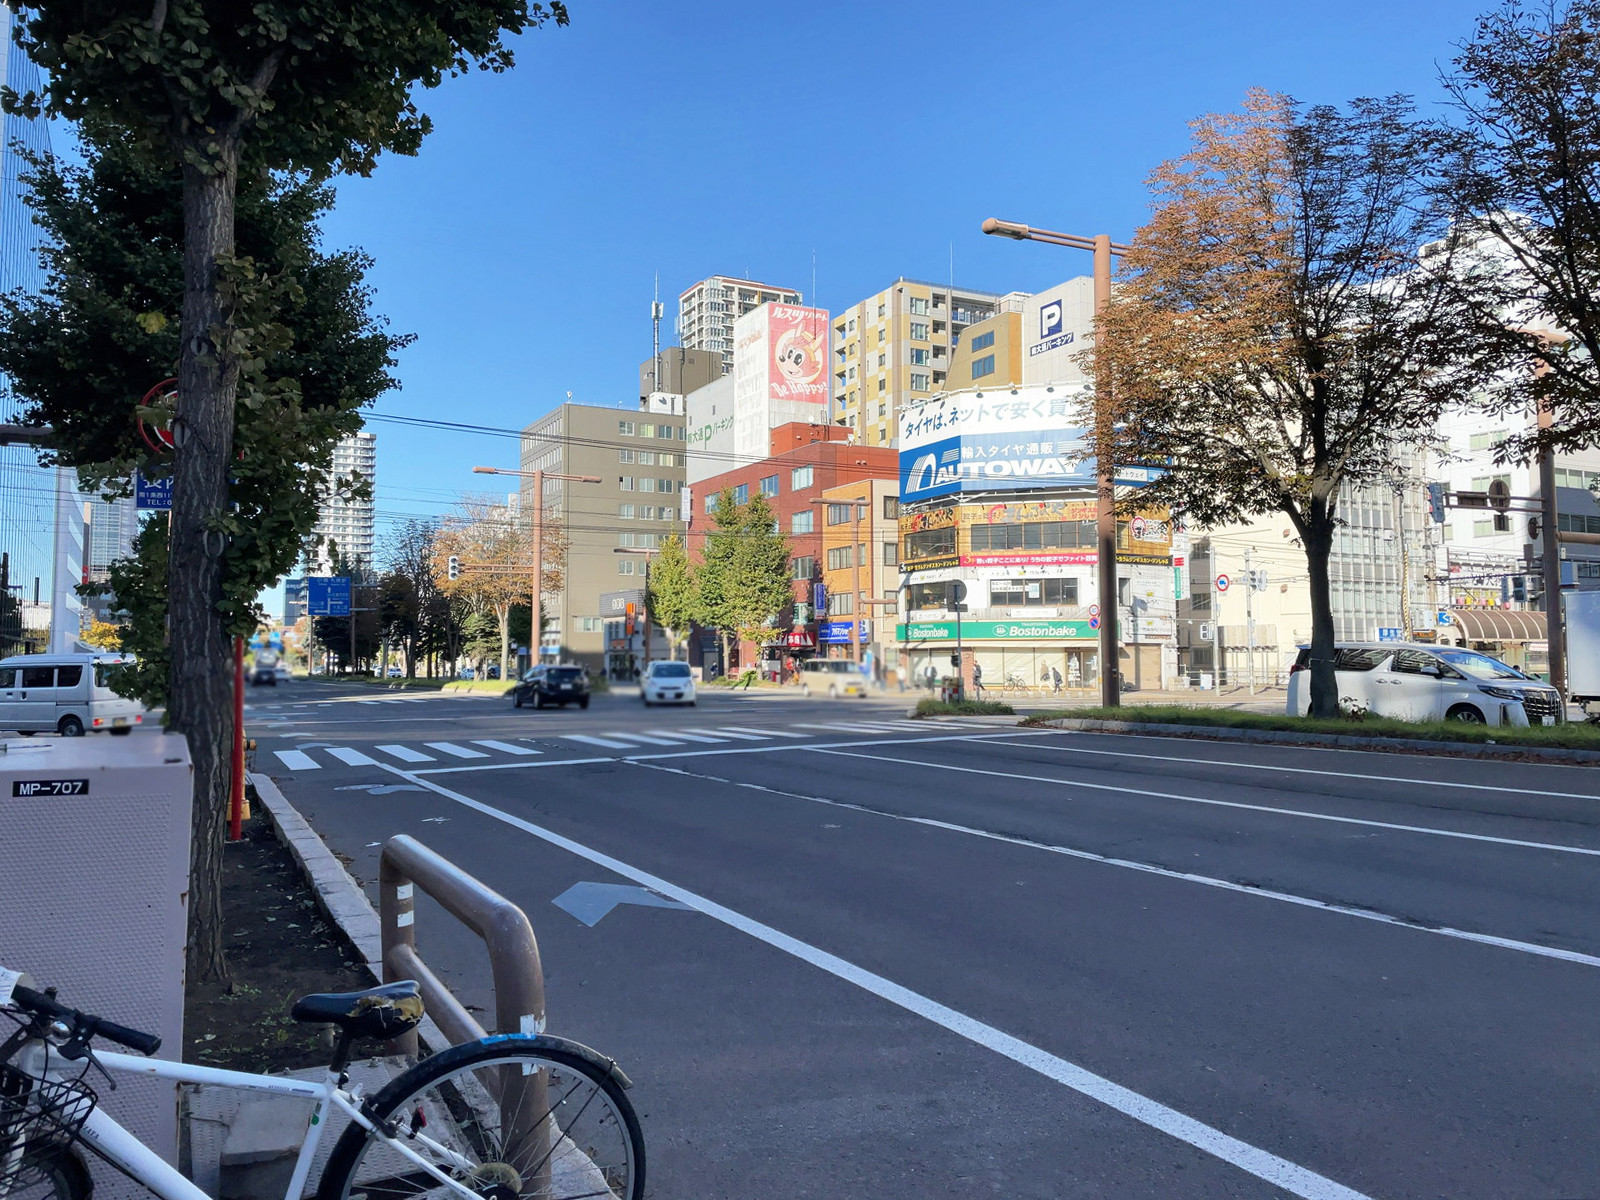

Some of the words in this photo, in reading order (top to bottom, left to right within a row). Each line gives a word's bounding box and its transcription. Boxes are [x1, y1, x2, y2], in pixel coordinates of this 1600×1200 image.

[1042, 304, 1061, 336] P
[770, 381, 789, 397] Be
[786, 379, 829, 395] Happy!
[961, 442, 1054, 460] 輸入タイヤ通販
[935, 457, 1081, 485] AUTOWAY
[913, 628, 949, 638] Bostonbake
[1009, 625, 1077, 637] Bostonbake
[20, 782, 82, 795] MP-707
